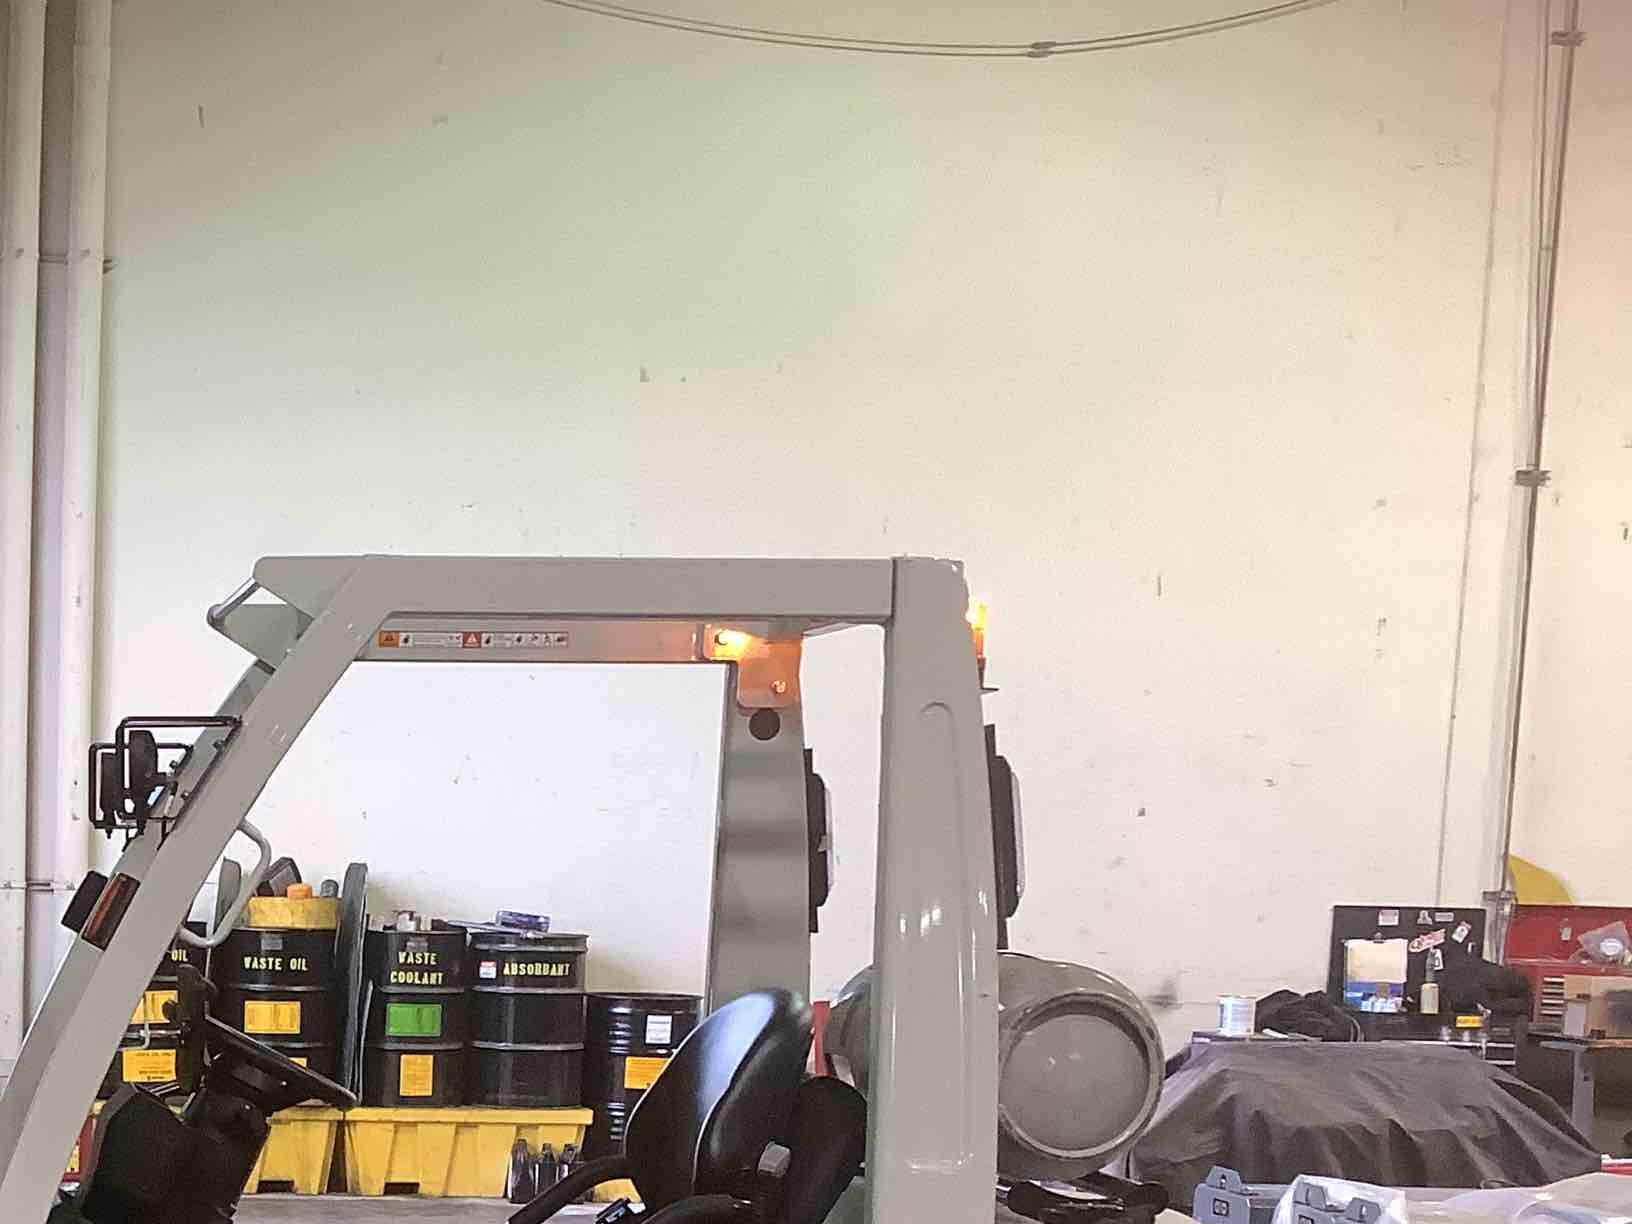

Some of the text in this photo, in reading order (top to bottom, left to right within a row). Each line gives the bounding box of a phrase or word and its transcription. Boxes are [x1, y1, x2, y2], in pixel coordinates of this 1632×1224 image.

[171, 949, 189, 962] OIL
[398, 951, 437, 966] WASTE
[243, 956, 309, 971] WASTE OIL
[502, 962, 571, 977] ABSORBANT
[390, 970, 444, 985] COOLANT
